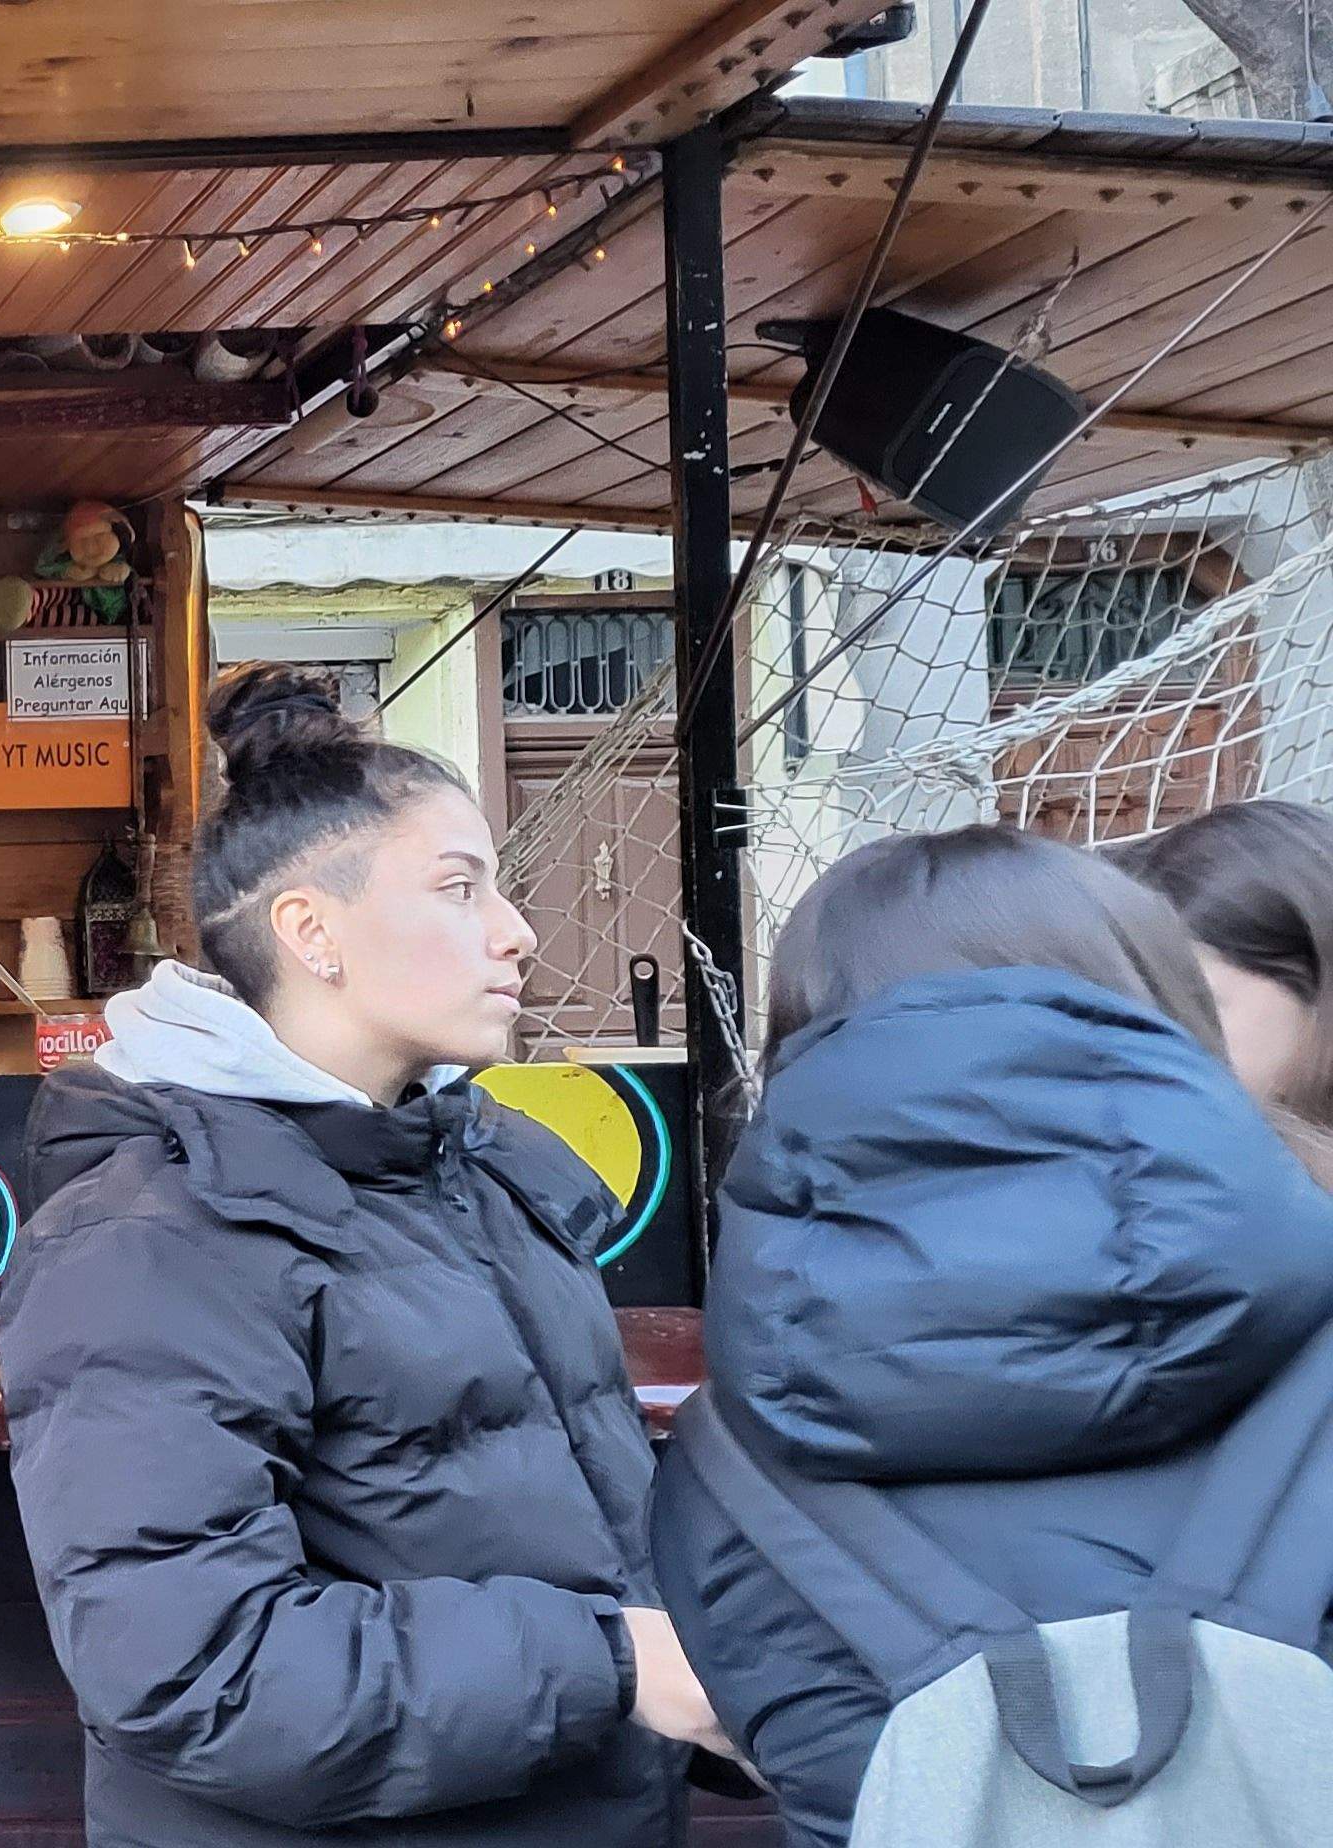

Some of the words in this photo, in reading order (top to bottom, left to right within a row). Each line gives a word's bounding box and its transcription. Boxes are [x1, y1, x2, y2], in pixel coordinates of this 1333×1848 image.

[1089, 540, 1117, 563] 16
[600, 569, 630, 590] 18
[22, 648, 121, 666] Información
[33, 674, 113, 692] Alérgenos
[14, 697, 94, 715] Preguntar
[99, 696, 128, 714] Aqu
[1, 743, 28, 767] YT
[35, 742, 110, 768] MUSIC
